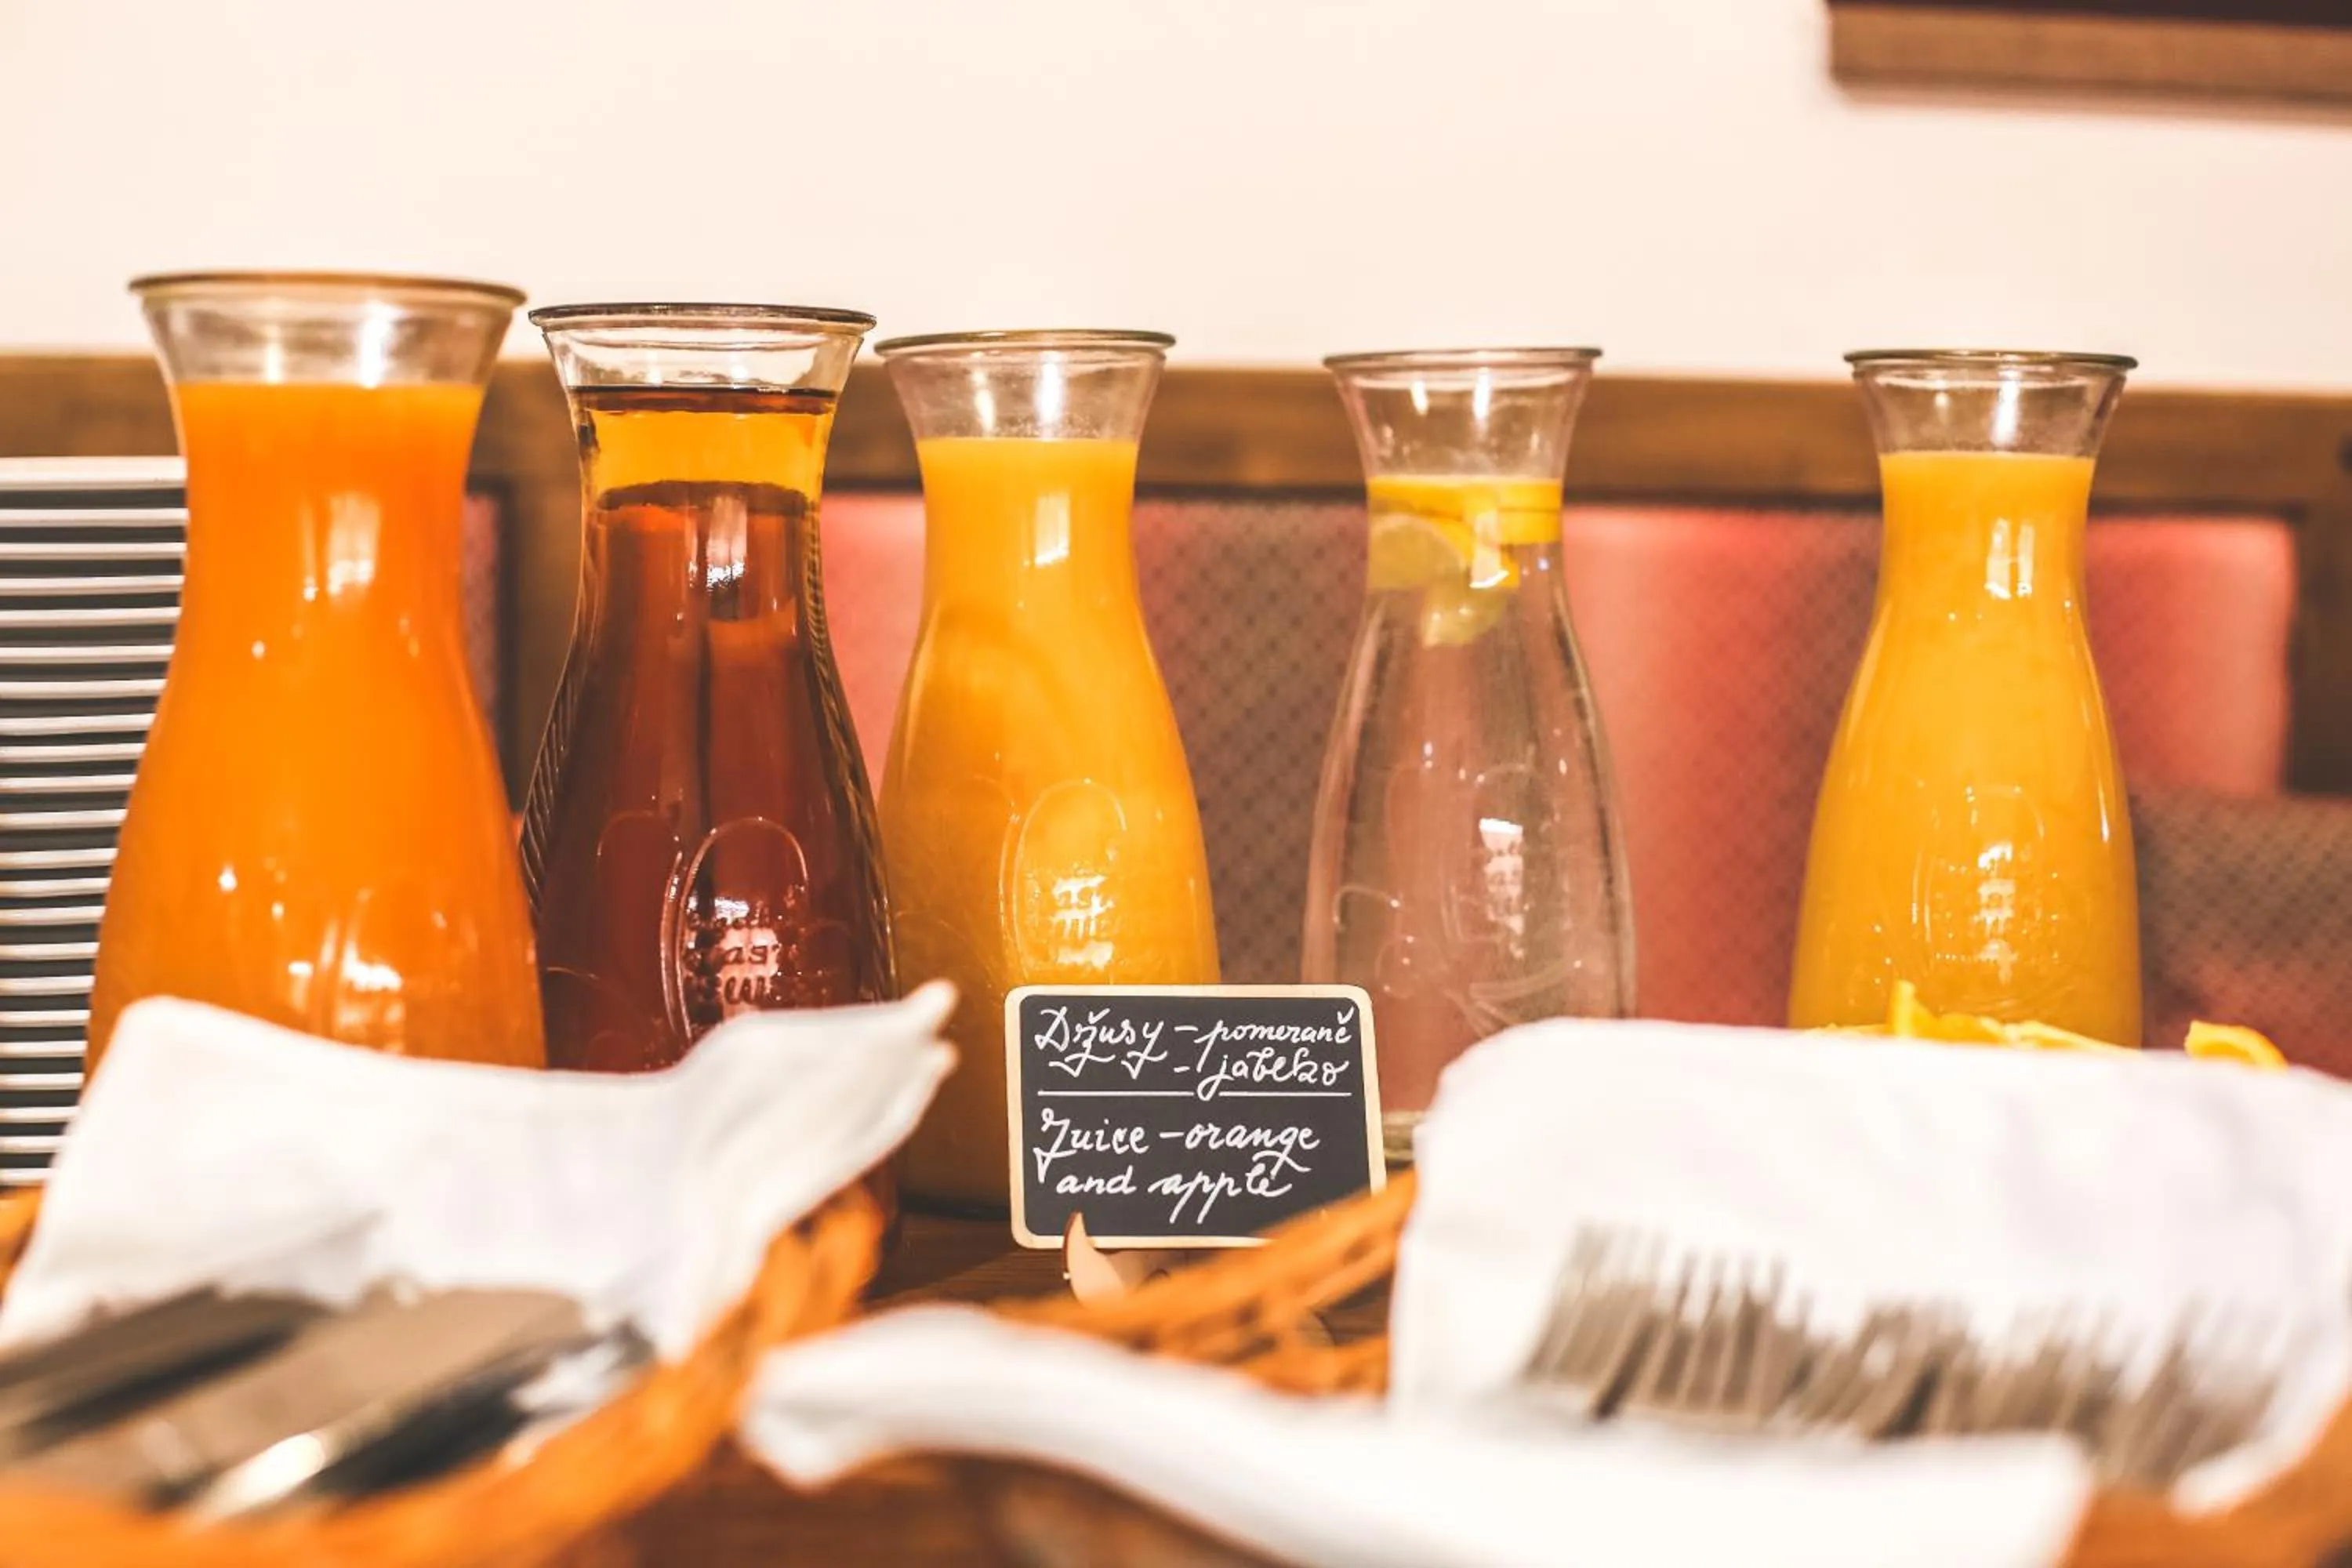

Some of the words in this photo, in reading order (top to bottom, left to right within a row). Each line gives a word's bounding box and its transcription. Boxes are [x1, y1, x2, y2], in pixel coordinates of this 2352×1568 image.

[1033, 1108, 1149, 1184] Juice
[1056, 1165, 1137, 1194] and
[1148, 1163, 1292, 1224] apple
